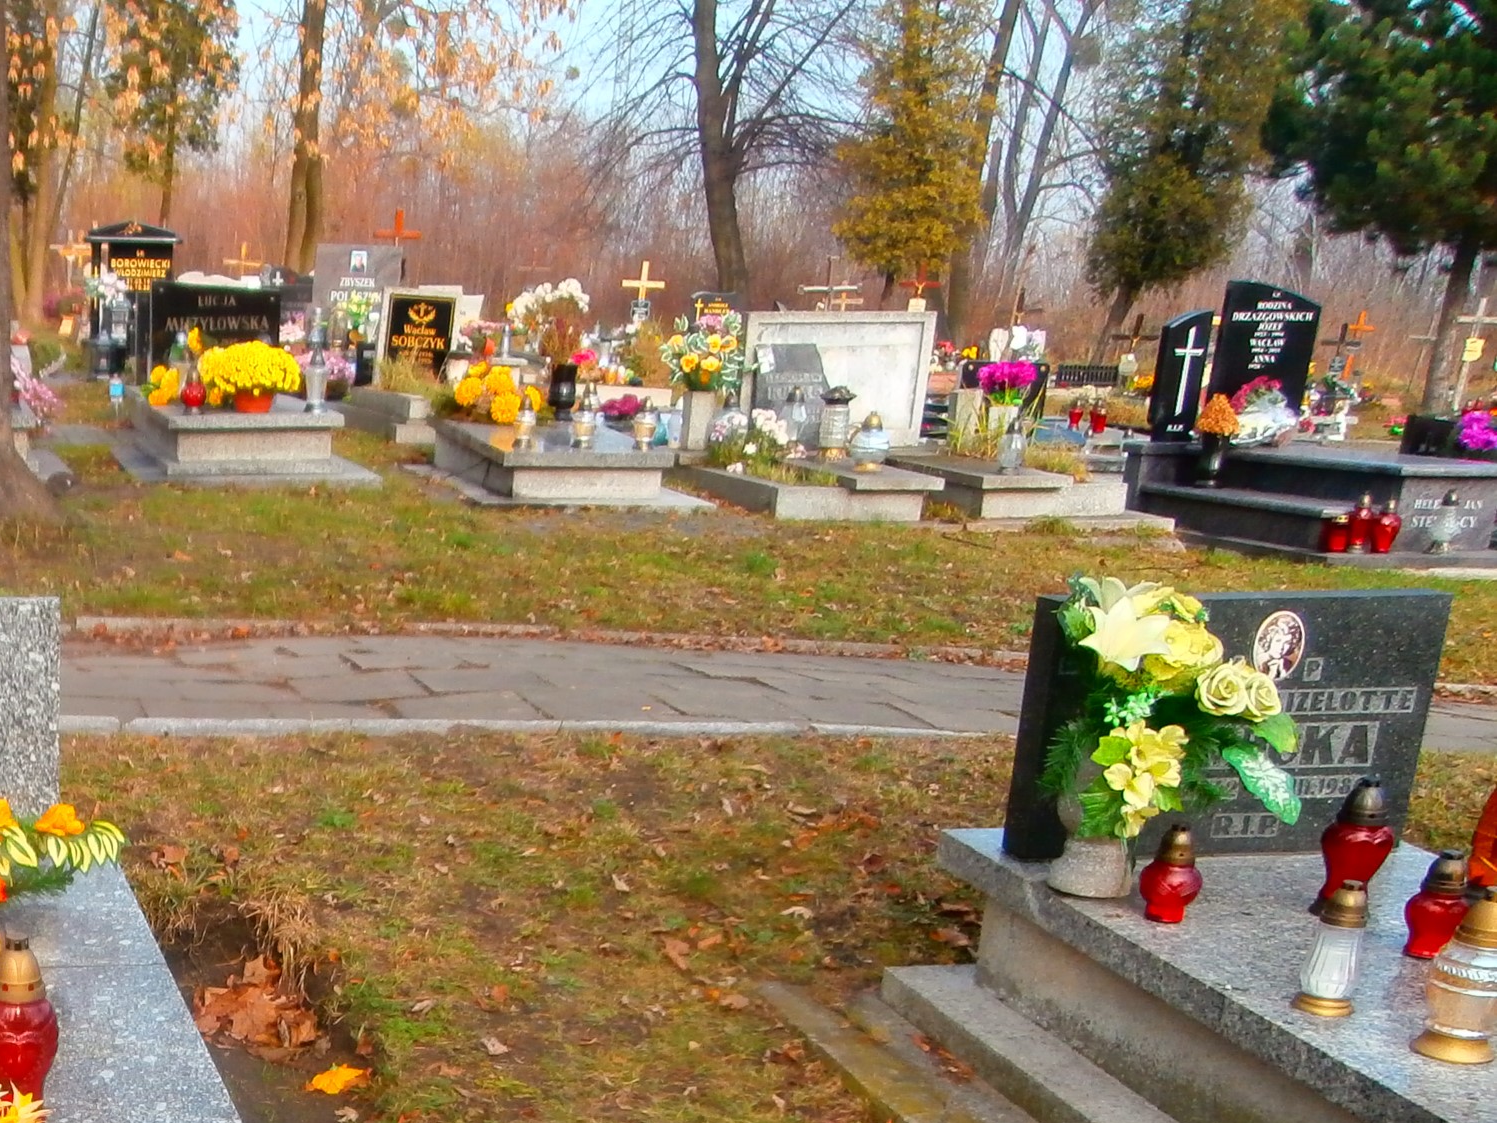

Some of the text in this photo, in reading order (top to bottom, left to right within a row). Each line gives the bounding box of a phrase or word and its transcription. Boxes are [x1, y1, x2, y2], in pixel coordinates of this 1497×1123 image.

[110, 258, 171, 269] BOROWIECKI
[339, 277, 376, 288] ZBYSZEK
[1257, 301, 1293, 310] RODZINA
[1231, 311, 1315, 322] DRZAZGOWSKICH
[391, 335, 446, 350] SOBCZYK
[1252, 355, 1276, 363] ANNA
